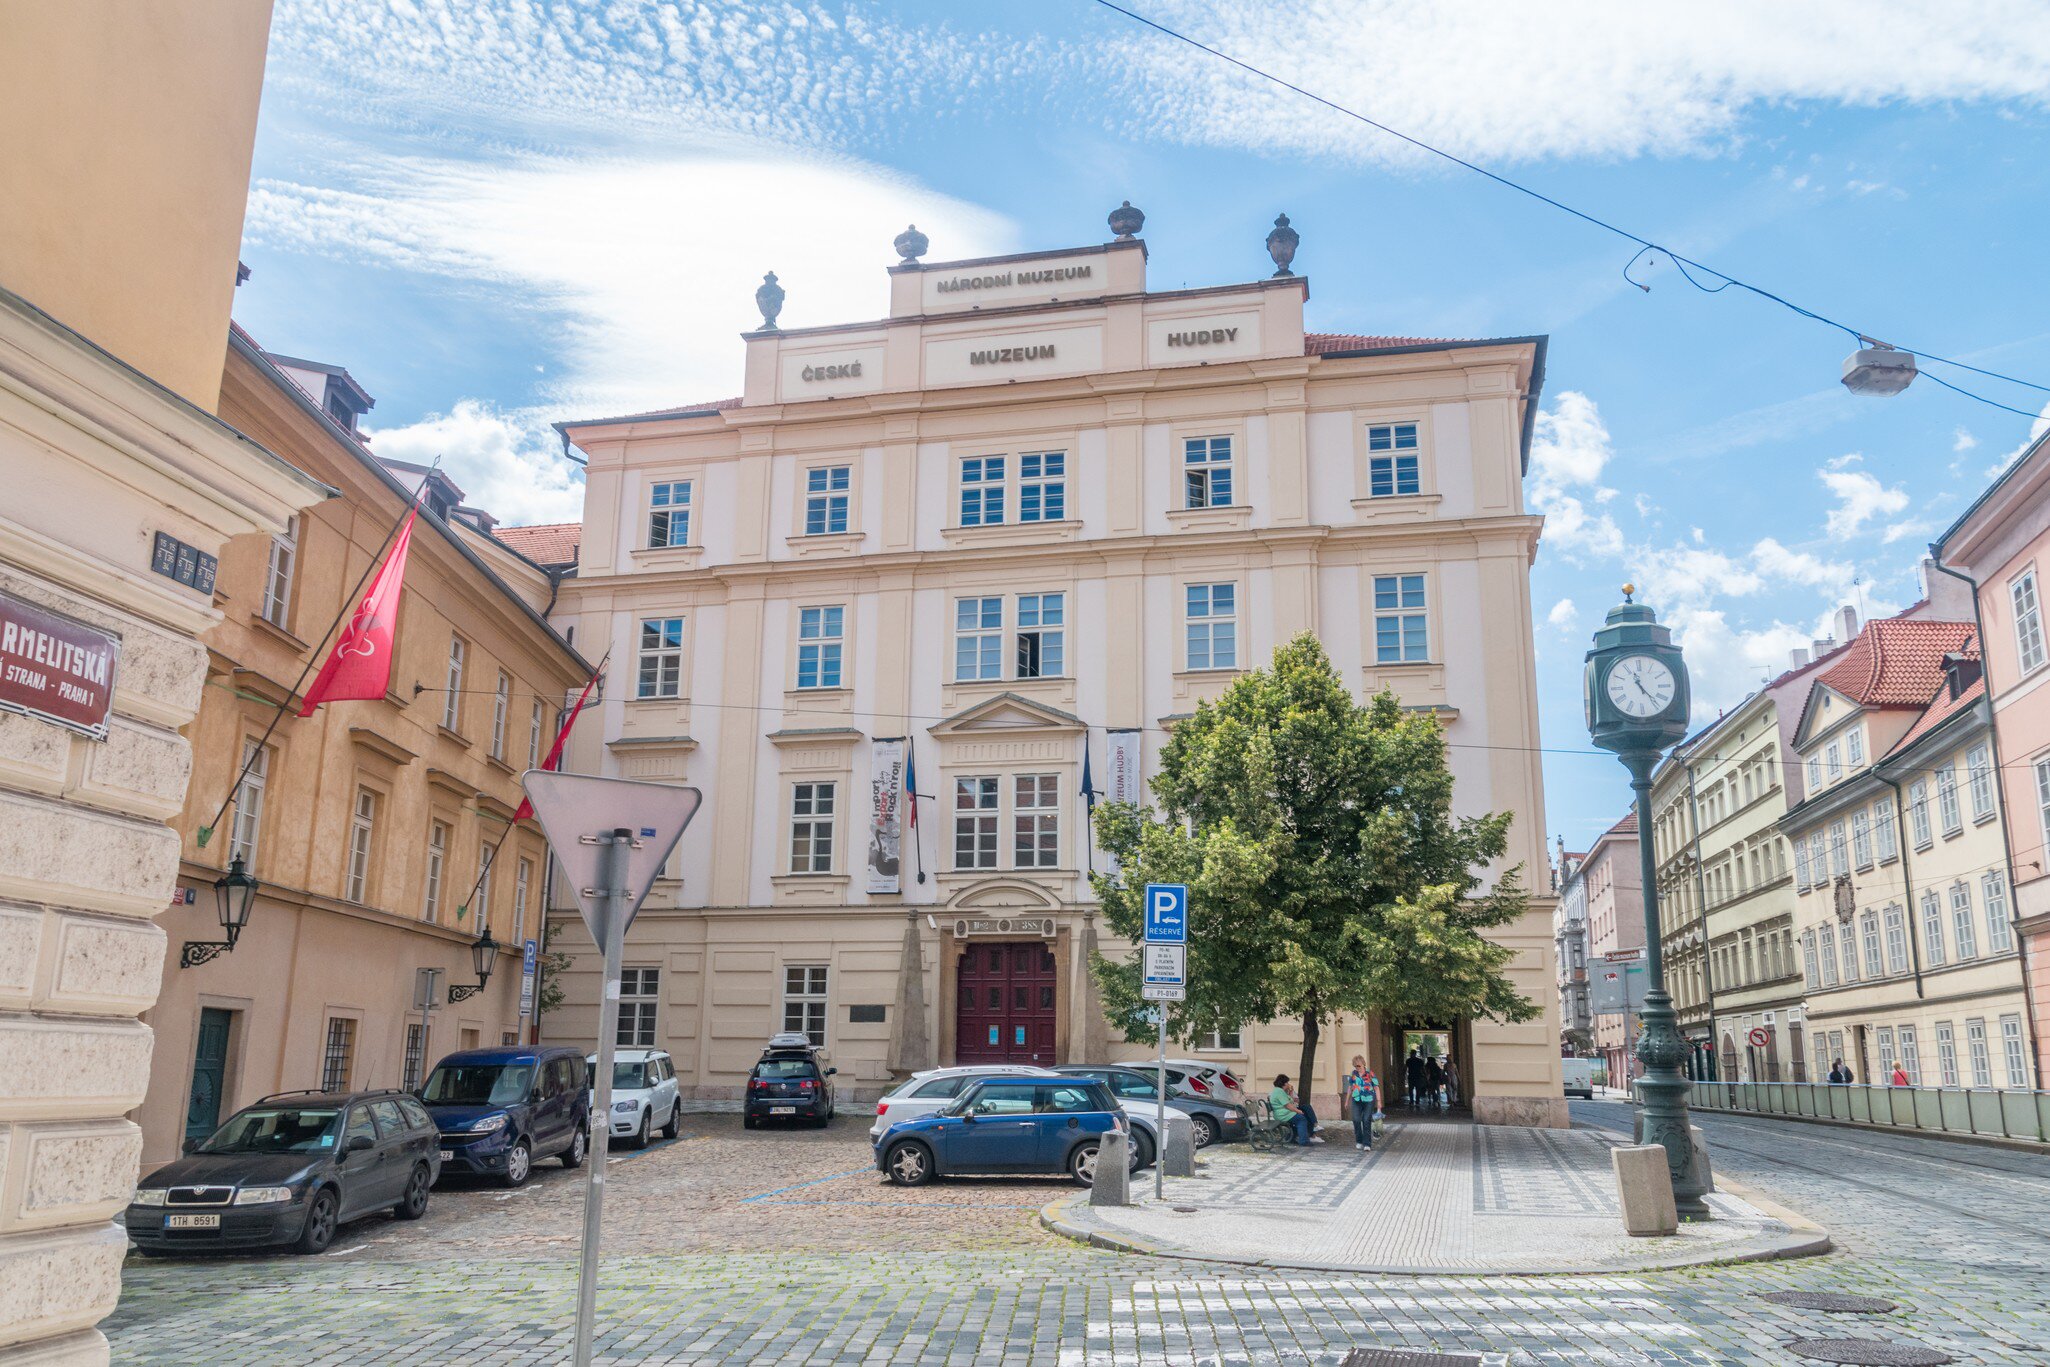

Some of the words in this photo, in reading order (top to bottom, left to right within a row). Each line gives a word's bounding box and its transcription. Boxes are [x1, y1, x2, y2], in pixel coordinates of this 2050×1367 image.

[937, 271, 1012, 293] NÁRODNÍ
[1017, 265, 1091, 285] MUZEUM
[801, 359, 862, 382] ČESKÉ
[970, 344, 1055, 365] MUZEUM
[1168, 327, 1238, 347] HUDBY
[1, 621, 107, 686] RMELITSKÁ
[5, 664, 47, 691] STRANA
[57, 681, 88, 706] PRAHA
[88, 692, 94, 707] 1
[1116, 746, 1124, 773] HUDBY
[1116, 775, 1124, 803] UZEUM
[1154, 891, 1177, 924] P
[172, 1216, 188, 1226] 1TH
[194, 1216, 216, 1226] 8591
